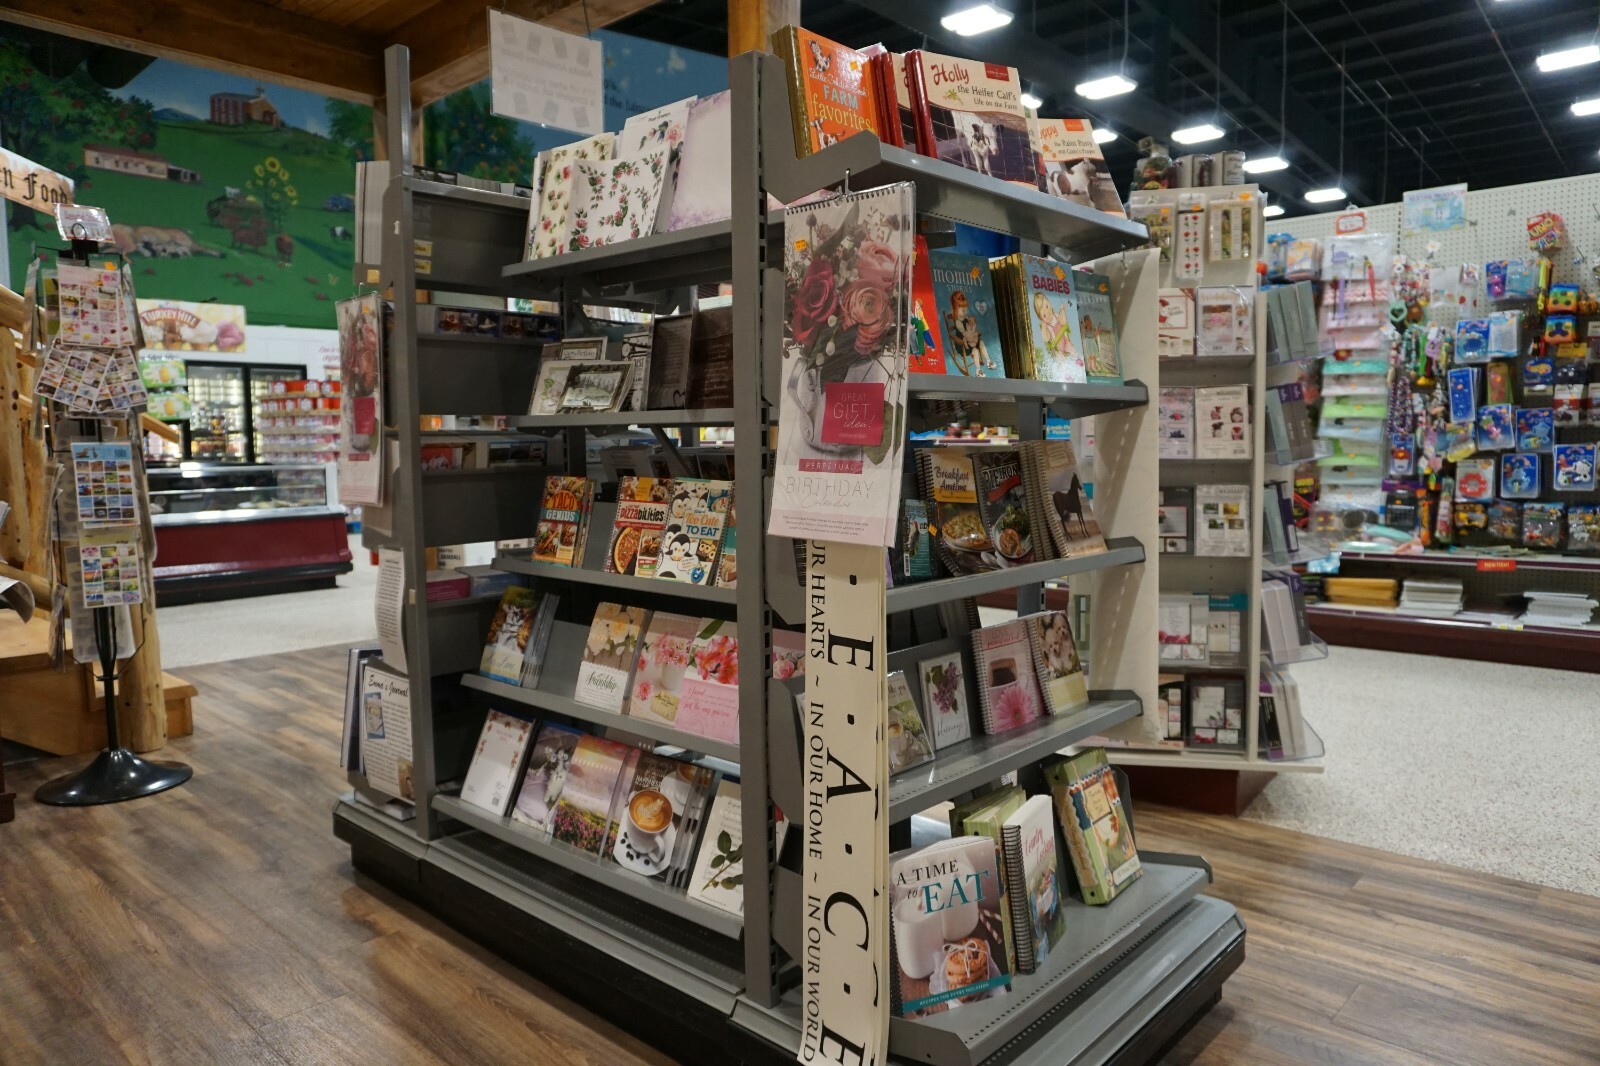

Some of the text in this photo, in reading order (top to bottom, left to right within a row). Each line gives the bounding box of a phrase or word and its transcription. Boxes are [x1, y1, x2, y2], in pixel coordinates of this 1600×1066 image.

[931, 62, 969, 86] Holly
[823, 85, 858, 109] FARM
[957, 85, 1017, 101] the Heifer Calf's
[813, 92, 871, 130] favorites
[1528, 218, 1554, 238] UNO
[1032, 274, 1071, 295] BABIES
[143, 308, 199, 328] TURKEY HILL
[842, 392, 867, 402] GREAT
[833, 402, 870, 419] GIFT
[806, 461, 855, 471] PERPETUAL
[934, 465, 969, 483] Breakfast
[786, 476, 875, 499] BIRTHDAY
[940, 480, 967, 496] Anytime
[553, 491, 575, 510] TACO
[546, 509, 576, 522] GENIUS
[620, 506, 664, 522] pizzabilities
[685, 513, 720, 527] Too Cute
[686, 525, 720, 537] TO EAT
[811, 574, 826, 660] HEARTS
[810, 701, 825, 728] IN
[809, 734, 825, 784] OUR
[809, 790, 823, 860] HOME
[896, 859, 960, 886] A TIME
[907, 870, 990, 915] to EAT
[807, 894, 822, 922] IN
[807, 926, 822, 974] OUR
[919, 983, 990, 1007] RECIPES FOR EVERY OCCASION
[803, 981, 821, 1063] WORLD
